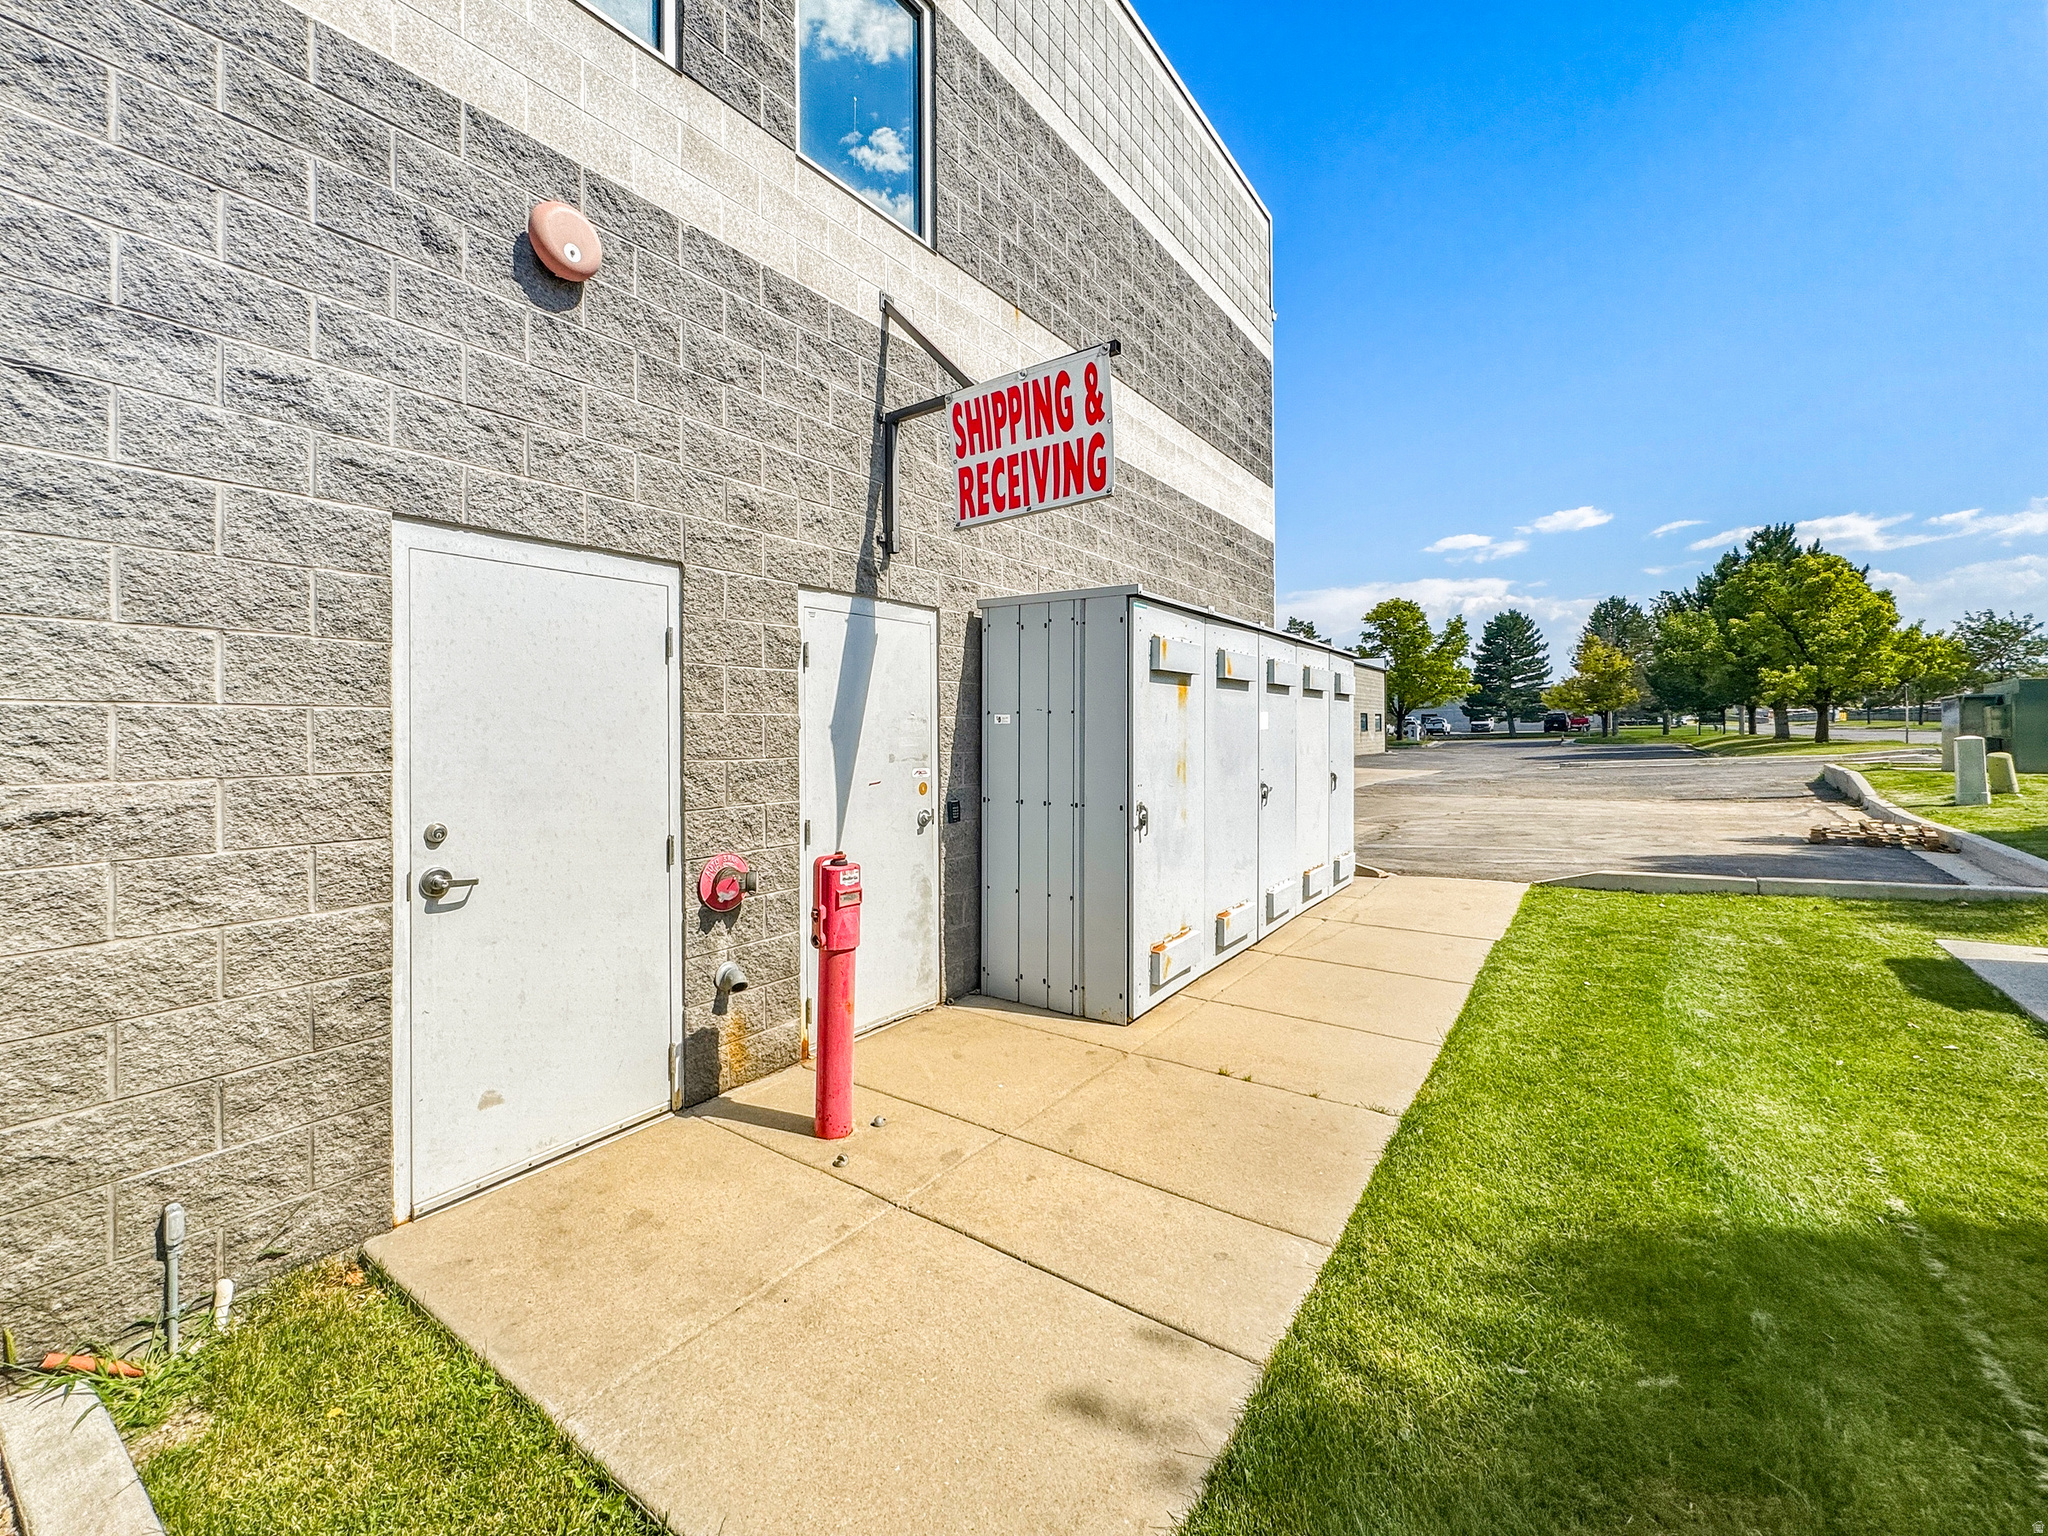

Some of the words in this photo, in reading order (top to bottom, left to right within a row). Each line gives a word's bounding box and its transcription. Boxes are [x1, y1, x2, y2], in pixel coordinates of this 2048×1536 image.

[952, 370, 1074, 460] SHIPPING
[1084, 361, 1105, 426] &
[958, 432, 1107, 521] RECEIVING
